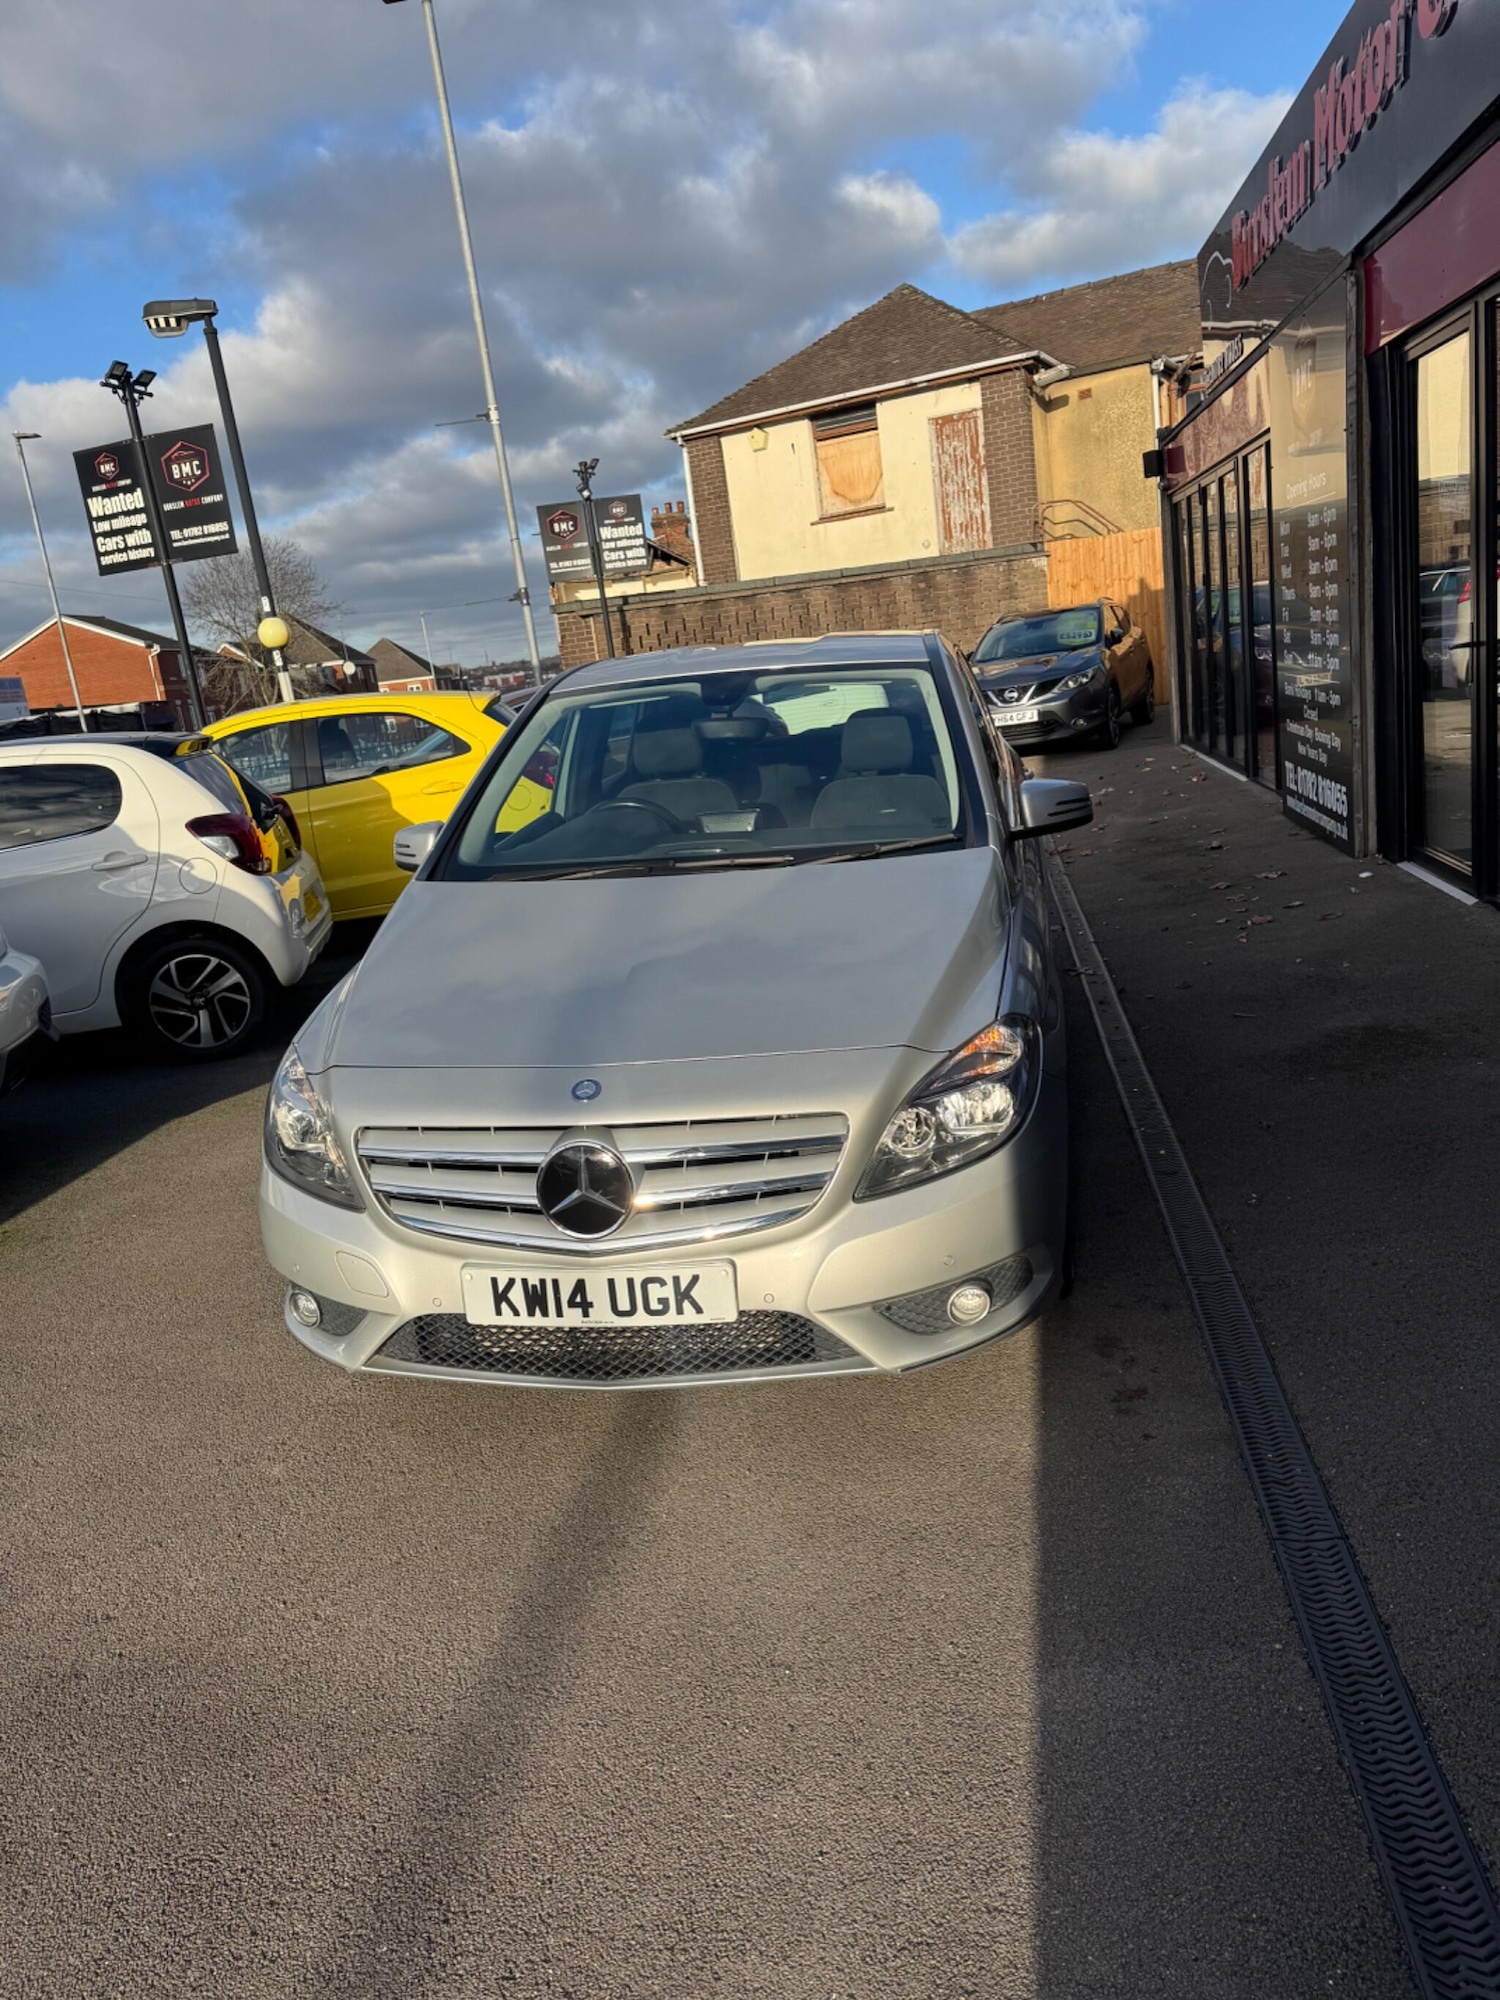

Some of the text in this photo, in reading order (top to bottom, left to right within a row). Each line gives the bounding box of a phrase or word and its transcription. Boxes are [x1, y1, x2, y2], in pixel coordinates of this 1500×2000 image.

[1314, 0, 1407, 191] Motor
[171, 460, 202, 479] BMC
[1286, 471, 1327, 502] Opening Hours
[87, 487, 145, 518] Wanted
[92, 512, 147, 534] Low mileage
[553, 521, 575, 533] BMC
[600, 522, 643, 540] Wanted
[1280, 520, 1290, 536] Mon
[96, 528, 152, 553] Cars with
[602, 538, 644, 549] Low mileage
[1281, 542, 1289, 558] Tue
[101, 547, 155, 566] service history
[603, 547, 646, 562] Cars with
[1281, 563, 1292, 579] Wed
[1281, 586, 1296, 600] Thurs
[1315, 726, 1331, 749] Boxing
[1331, 732, 1341, 752] Day
[490, 1274, 704, 1318] KW14 UGK
